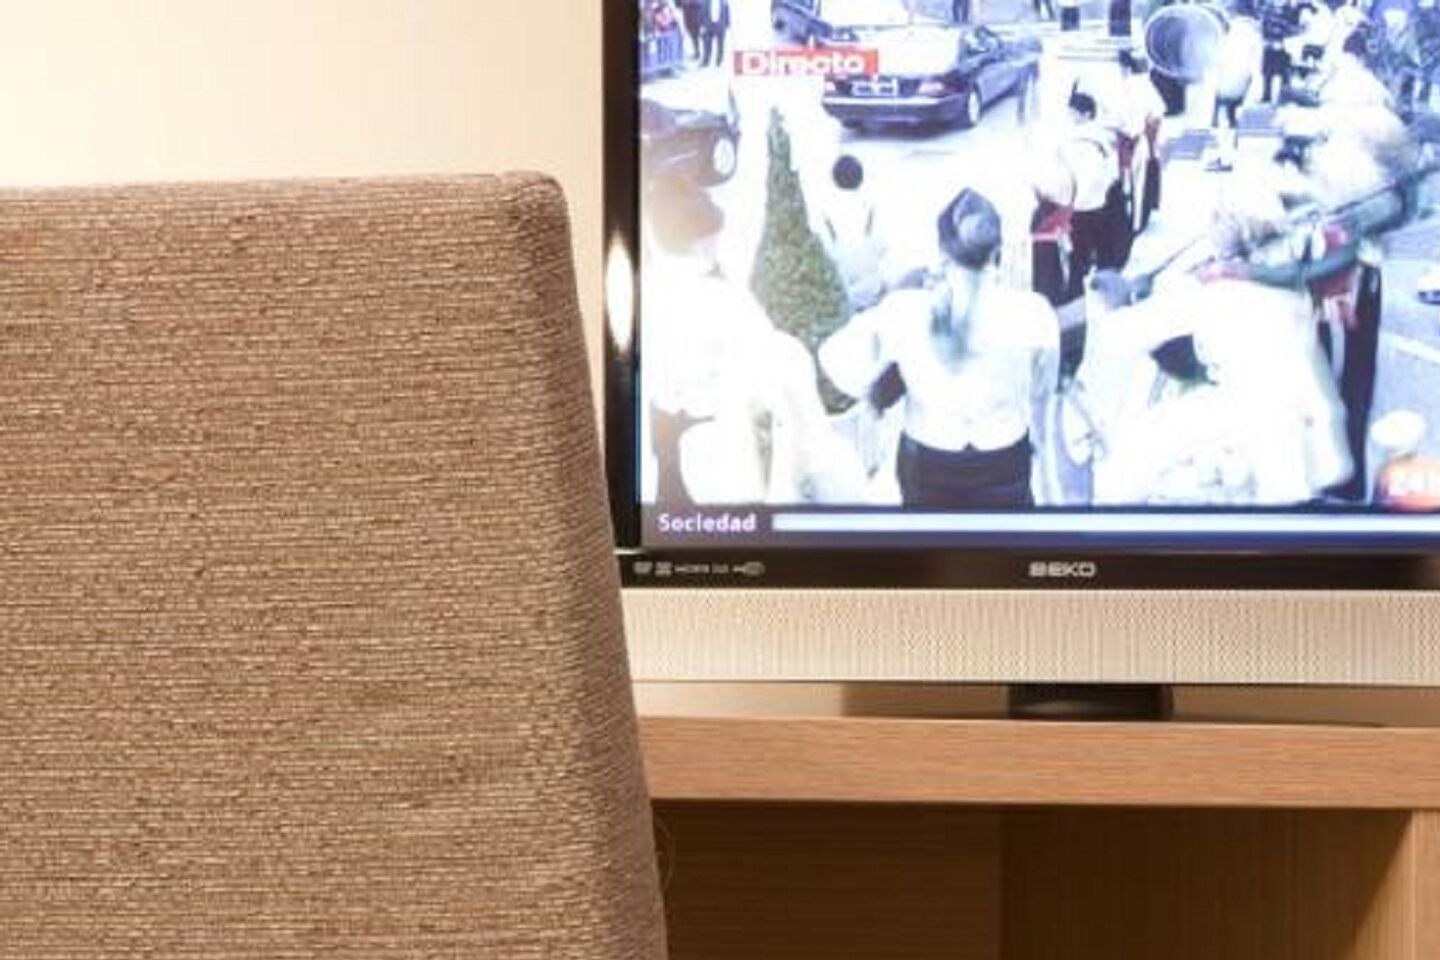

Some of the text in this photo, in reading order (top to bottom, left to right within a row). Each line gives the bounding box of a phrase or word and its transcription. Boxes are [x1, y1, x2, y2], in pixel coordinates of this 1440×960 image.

[742, 51, 865, 76] Directo
[658, 512, 757, 532] Sociedad
[1028, 561, 1097, 578] BEKO
